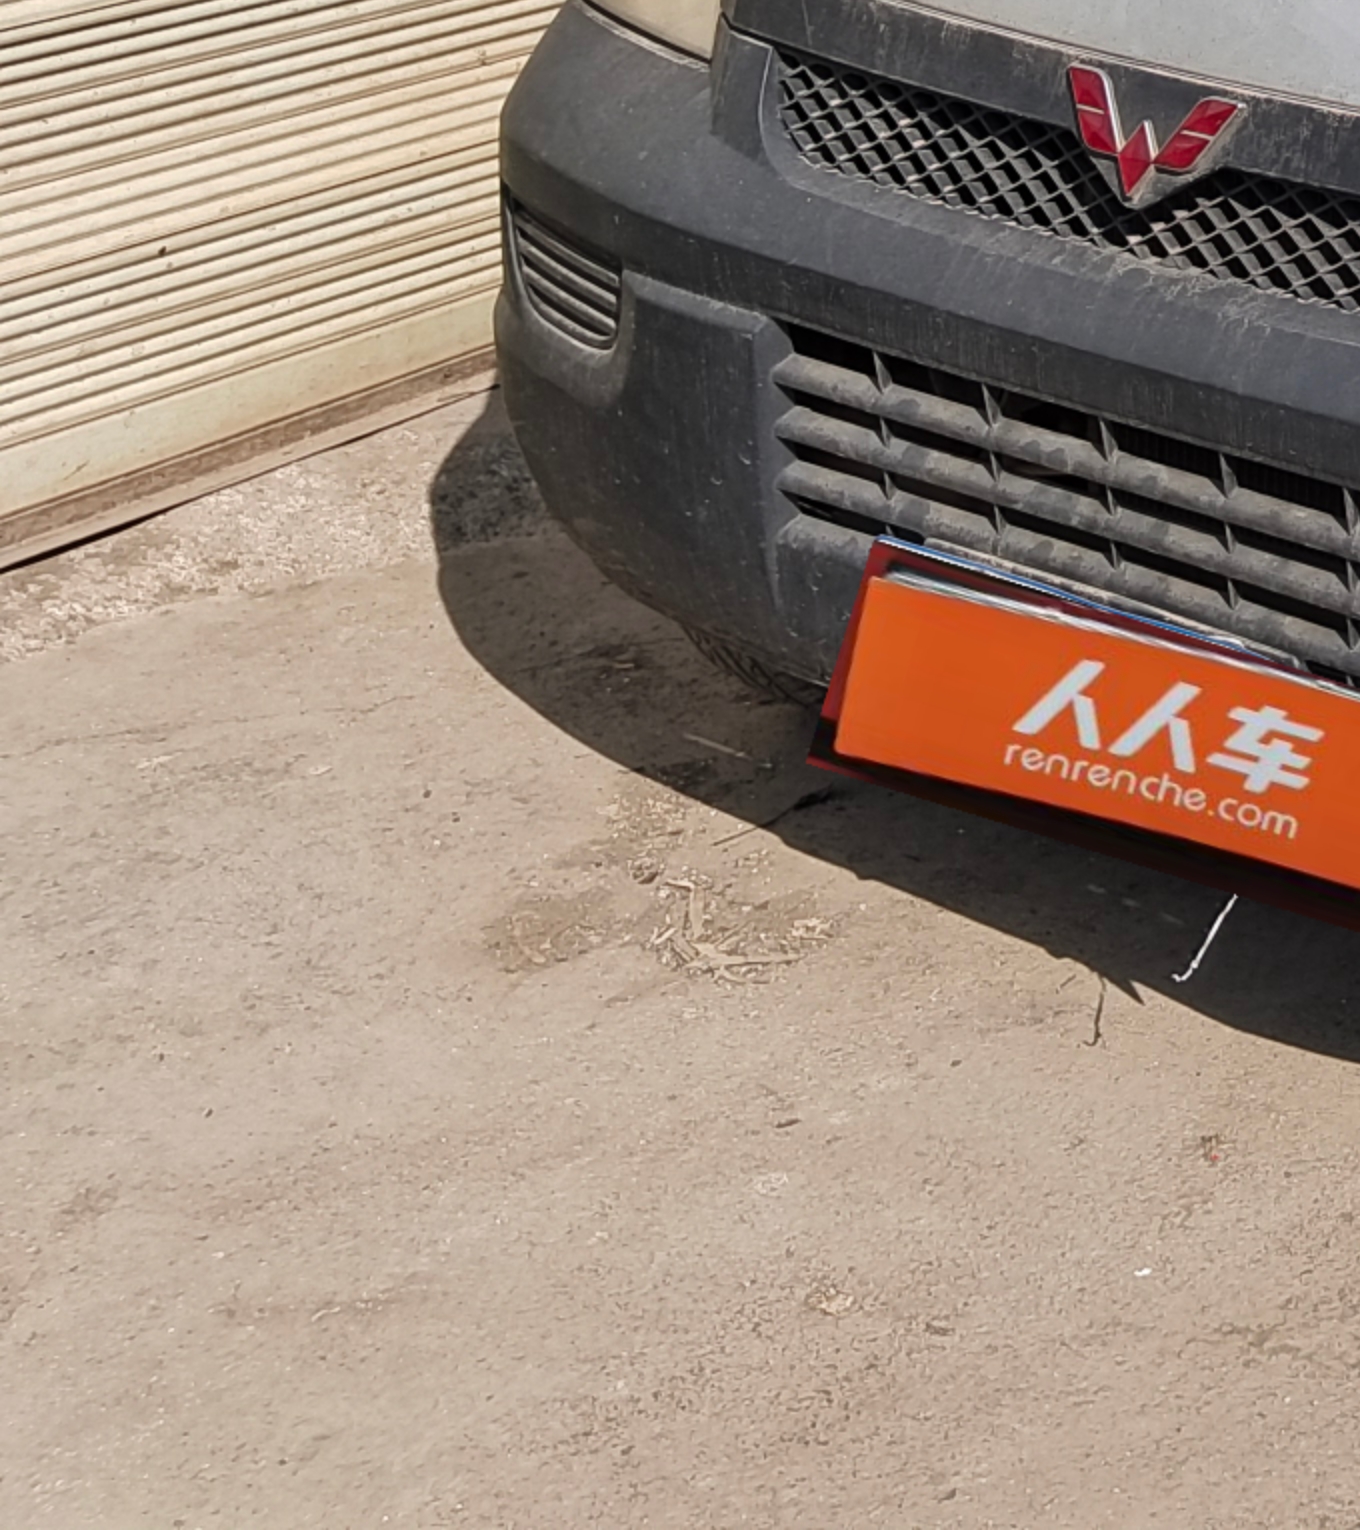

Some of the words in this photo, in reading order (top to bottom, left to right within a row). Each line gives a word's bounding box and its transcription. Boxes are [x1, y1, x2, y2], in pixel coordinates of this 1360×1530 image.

[1012, 660, 1324, 794] 人人车
[1004, 741, 1299, 839] renrenche.com
